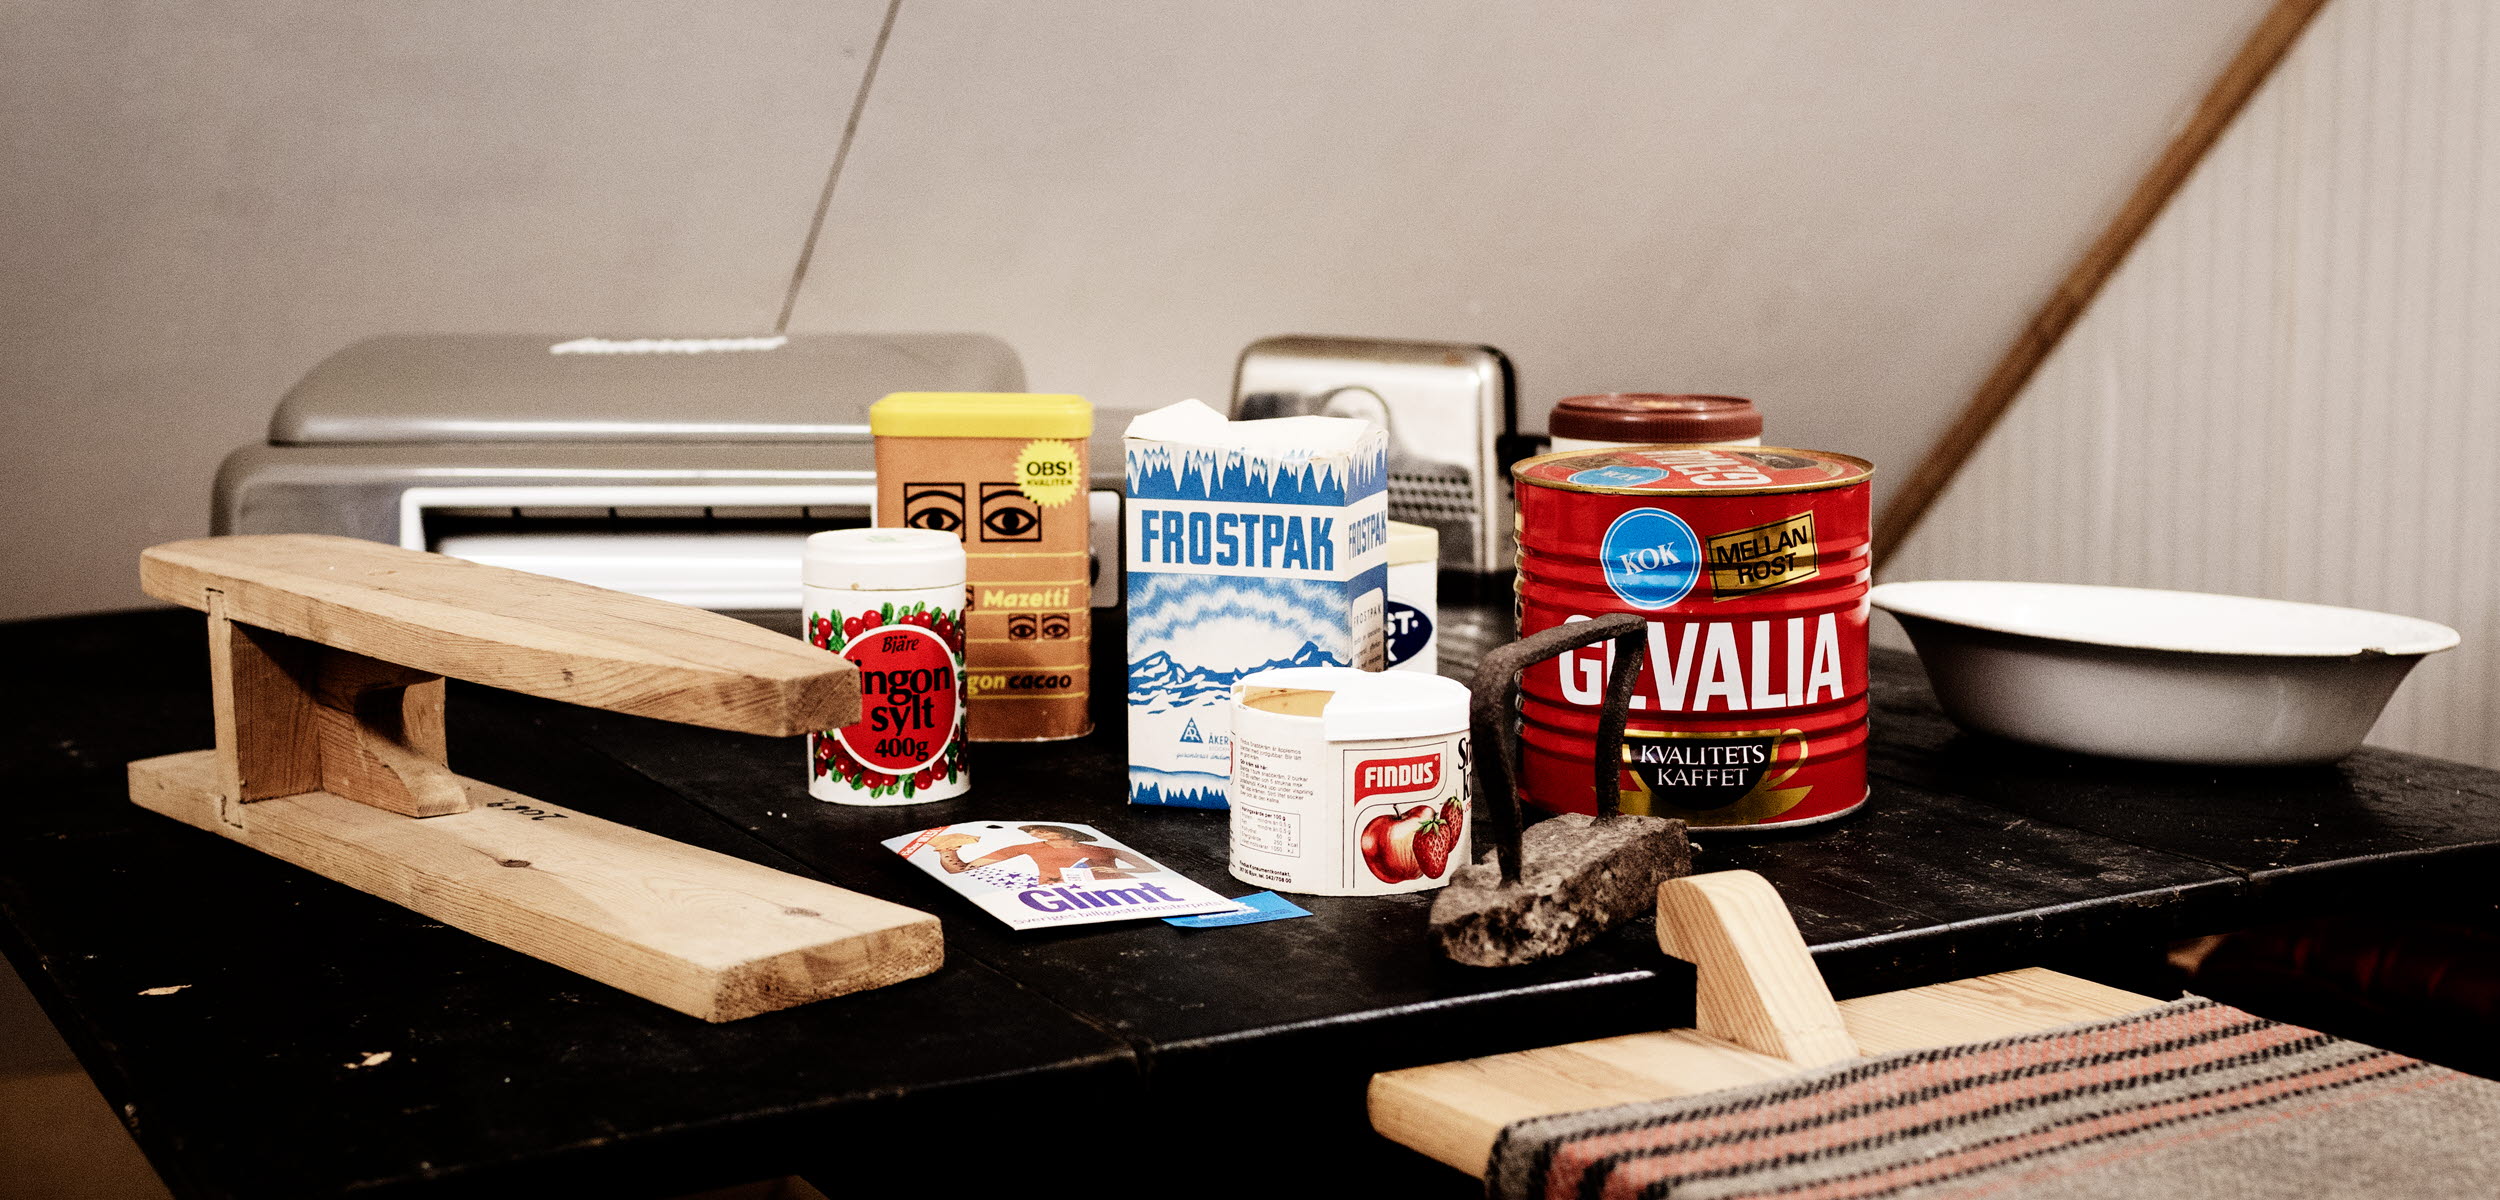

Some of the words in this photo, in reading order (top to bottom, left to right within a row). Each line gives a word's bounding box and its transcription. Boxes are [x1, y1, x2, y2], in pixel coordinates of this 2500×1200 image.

[1026, 461, 1073, 476] OBS!
[1142, 510, 1334, 571] FROSTPAK
[1349, 510, 1387, 561] FROSTPAK
[1716, 525, 1808, 564] MELLAN
[1619, 541, 1681, 576] KOK
[1737, 552, 1798, 585] ROST
[983, 587, 1070, 608] Mazetti
[1353, 603, 1382, 625] FROSTPAK
[882, 635, 920, 653] Bjäre
[1009, 674, 1072, 689] cacao
[871, 694, 935, 736] sylt
[875, 738, 929, 762] 400g
[1639, 744, 1766, 766] KVALITETS
[1364, 762, 1434, 788] FINDUS
[1657, 767, 1749, 788] KAFFET
[1018, 882, 1186, 913] Glimt
